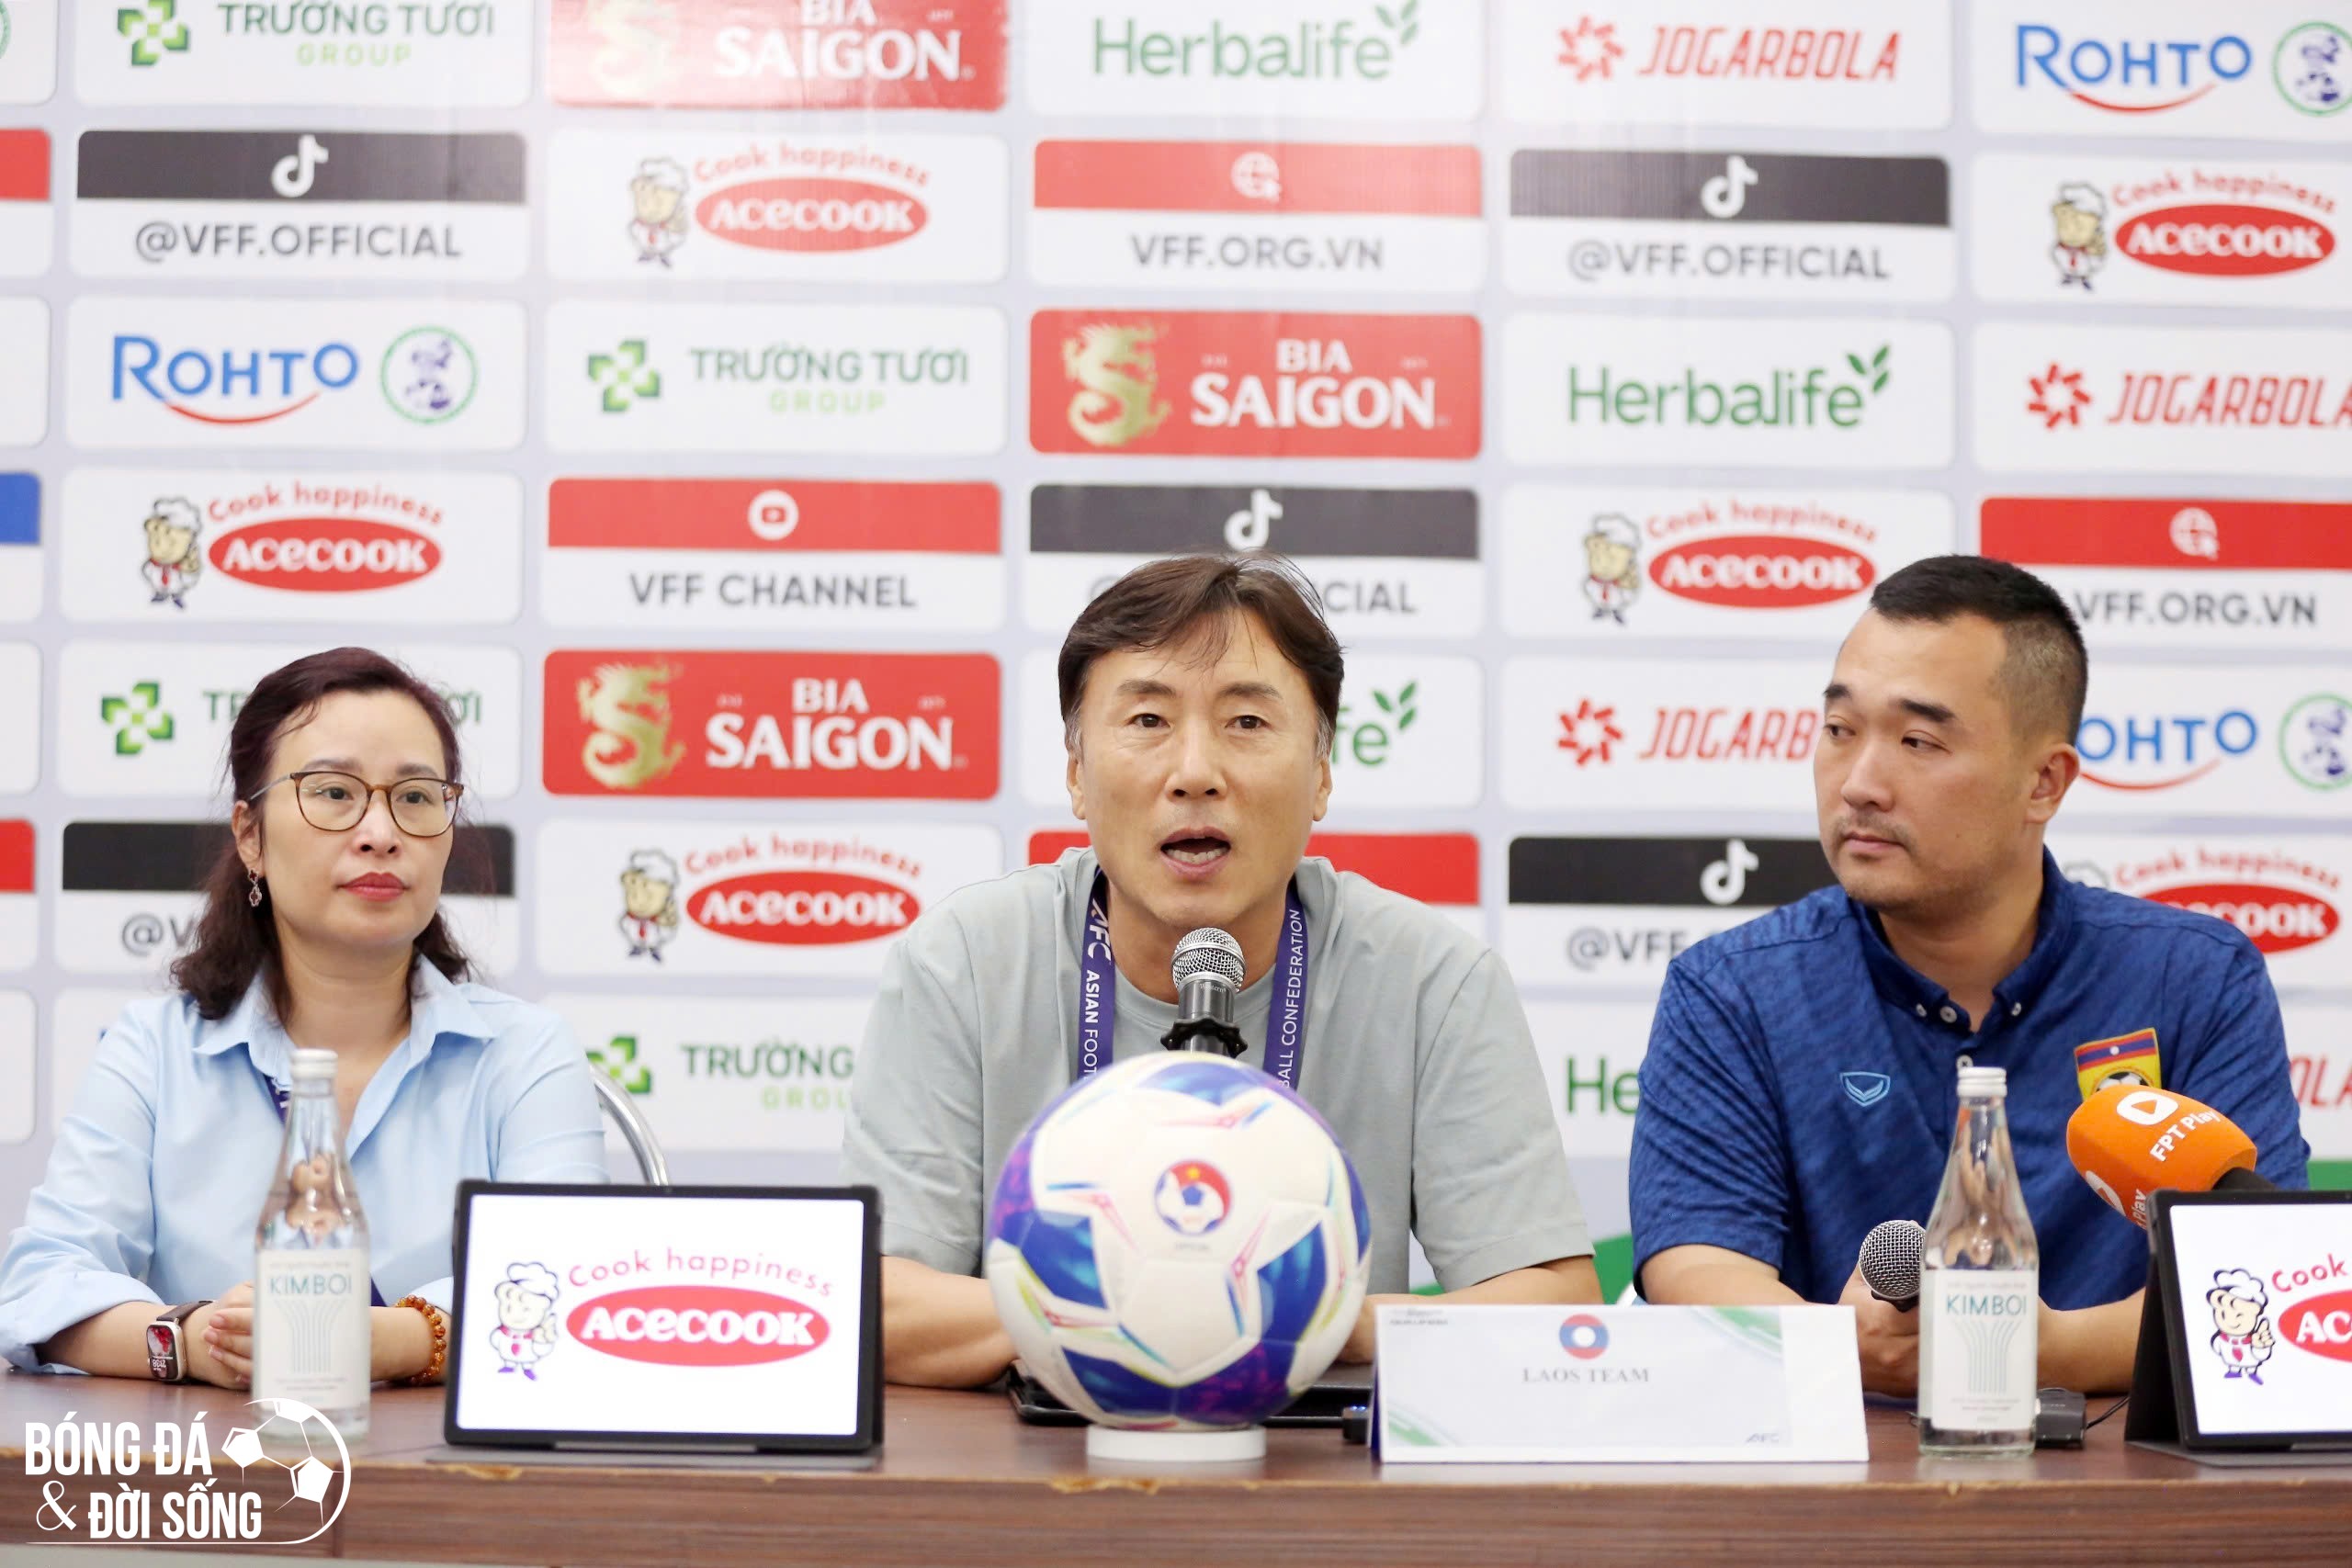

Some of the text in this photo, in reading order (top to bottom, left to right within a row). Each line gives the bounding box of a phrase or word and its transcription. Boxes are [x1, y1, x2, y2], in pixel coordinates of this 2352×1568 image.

[801, 0, 878, 26] BIA
[296, 42, 412, 65] GROUP
[715, 27, 962, 81] SAIGON
[1092, 18, 1391, 78] Herbalife
[1637, 27, 1901, 81] JOGARBOLA
[694, 140, 930, 186] Cook happiness
[2112, 168, 2336, 214] Cook happiness
[135, 220, 462, 264] @VFF.OFFICIAL
[1130, 233, 1384, 269] VFF.ORG.VN
[1567, 240, 1891, 280] @VFF.OFFICIAL
[1275, 338, 1353, 374] BIA
[769, 389, 886, 415] GROUP
[1190, 371, 1437, 431] SAIGON
[1567, 366, 1865, 427] Herbalife
[208, 479, 444, 527] Cook happiness
[1646, 501, 1878, 543] Cook happiness
[629, 573, 916, 608] VFF CHANNEL
[2075, 591, 2318, 626] VFF.ORG.VN
[792, 677, 869, 715] BIA
[705, 711, 955, 772] SAIGON
[1636, 707, 1817, 763] JOGARB
[2075, 710, 2258, 762] OHTO
[684, 831, 922, 878] Cook happiness
[2115, 843, 2340, 890] Cook happiness
[1084, 969, 1100, 1023] ASIAN
[1281, 908, 1304, 1046] CONFEDERATION
[2150, 1109, 2222, 1162] FPT Play
[268, 1272, 353, 1296] KIMBOI
[568, 1247, 833, 1298] Cook happiness
[2272, 1253, 2349, 1292] Cook
[1946, 1293, 2027, 1316] KIMBOI
[1521, 1368, 1650, 1383] LAOS TEAM
